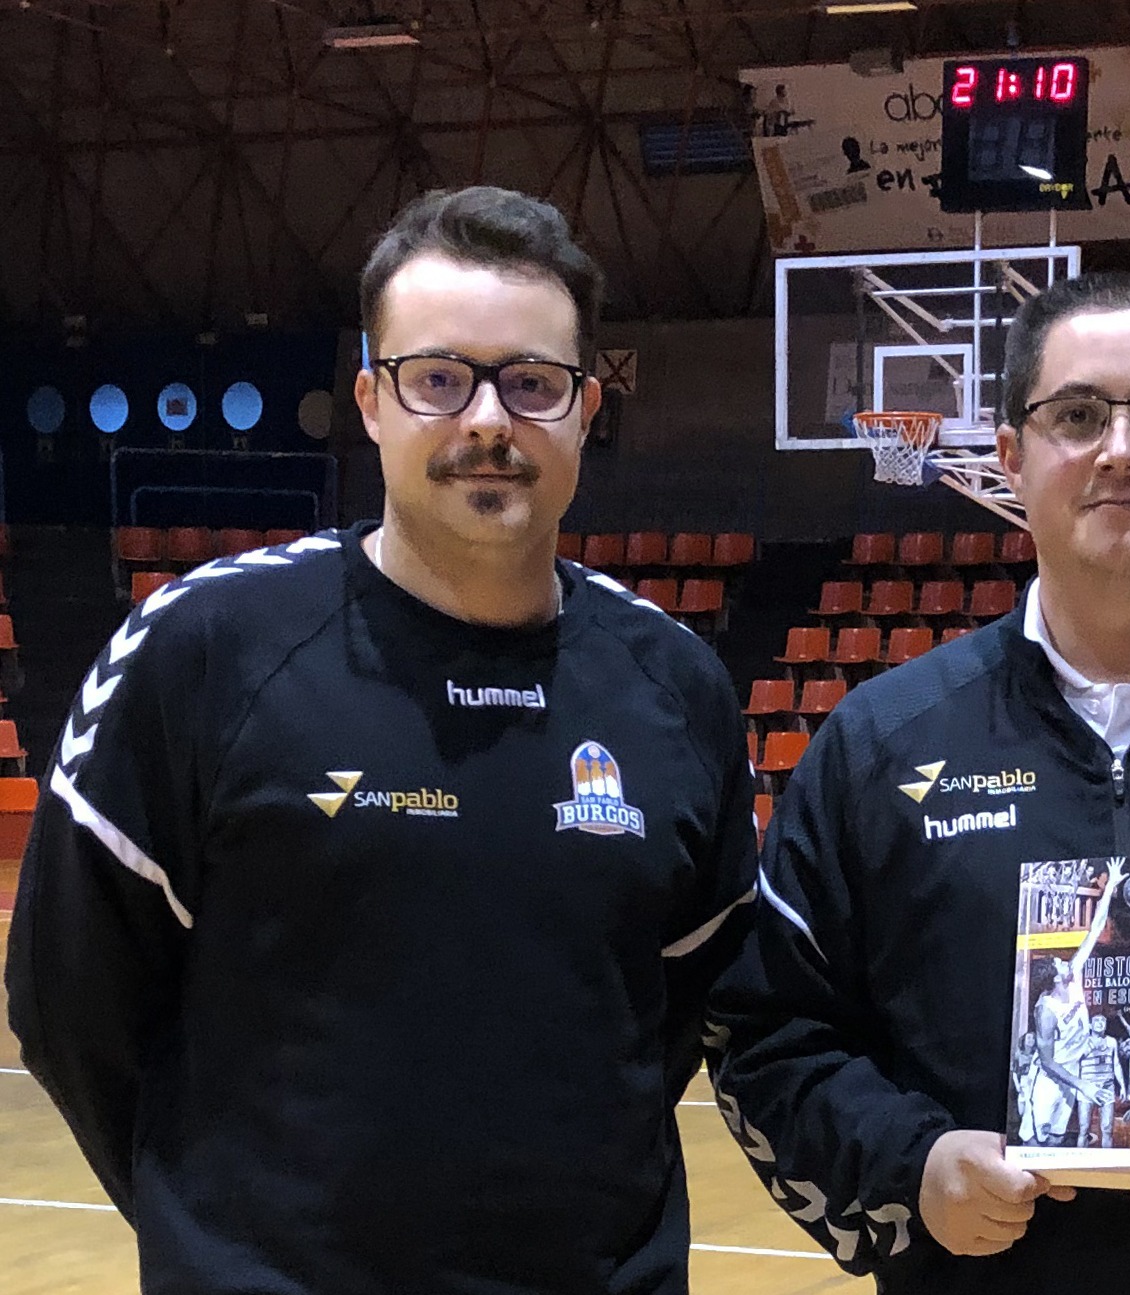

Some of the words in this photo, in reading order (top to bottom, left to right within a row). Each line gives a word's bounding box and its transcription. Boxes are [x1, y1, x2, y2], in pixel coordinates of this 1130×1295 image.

[952, 64, 1075, 103] 21:10
[876, 168, 916, 191] en
[447, 679, 546, 708] hummel
[562, 803, 641, 831] BURGOS
[924, 803, 1017, 841] hummel
[1084, 978, 1103, 988] DEL
[1084, 990, 1103, 1006] EN
